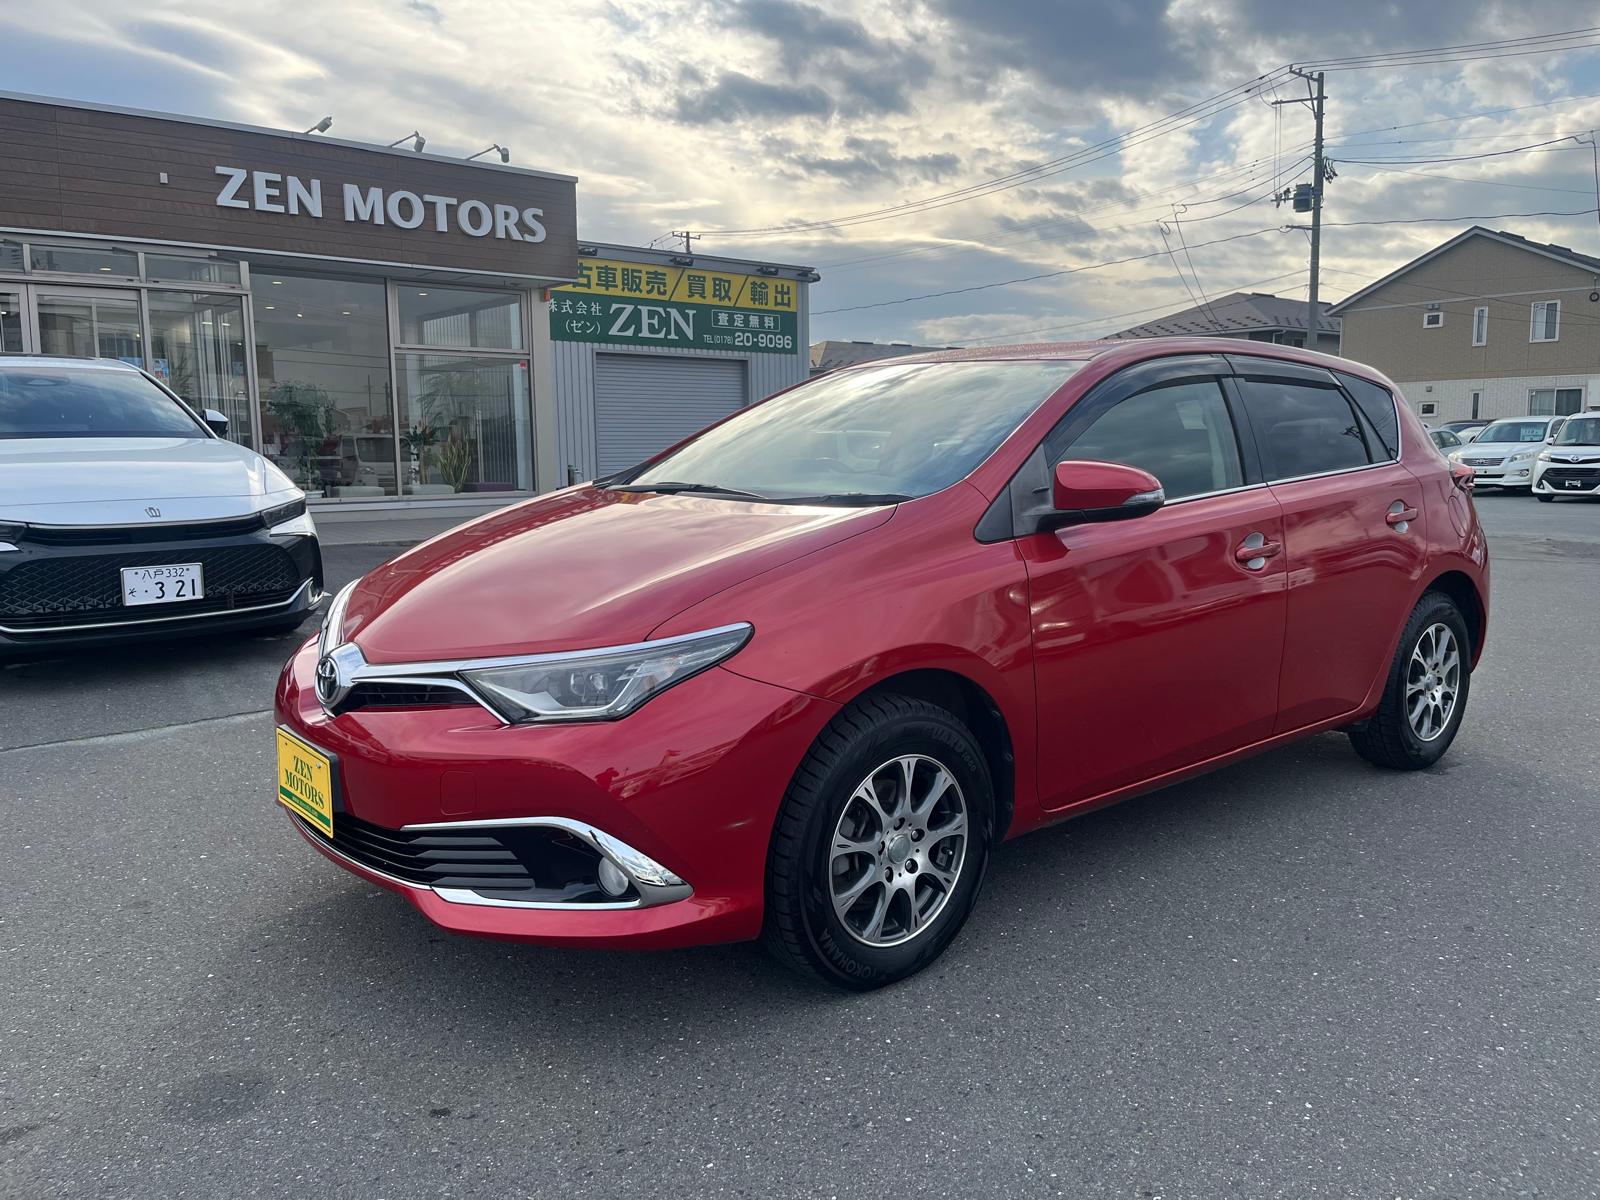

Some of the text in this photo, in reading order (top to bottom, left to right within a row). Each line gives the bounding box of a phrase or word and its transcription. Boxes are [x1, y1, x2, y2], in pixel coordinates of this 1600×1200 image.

[215, 166, 547, 243] ZEN MOTORS
[608, 303, 697, 341] ZEN
[717, 312, 775, 329] 査定無料
[734, 332, 792, 349] 20-9096
[293, 755, 313, 782] ZEN
[284, 768, 325, 810] MOTORS
